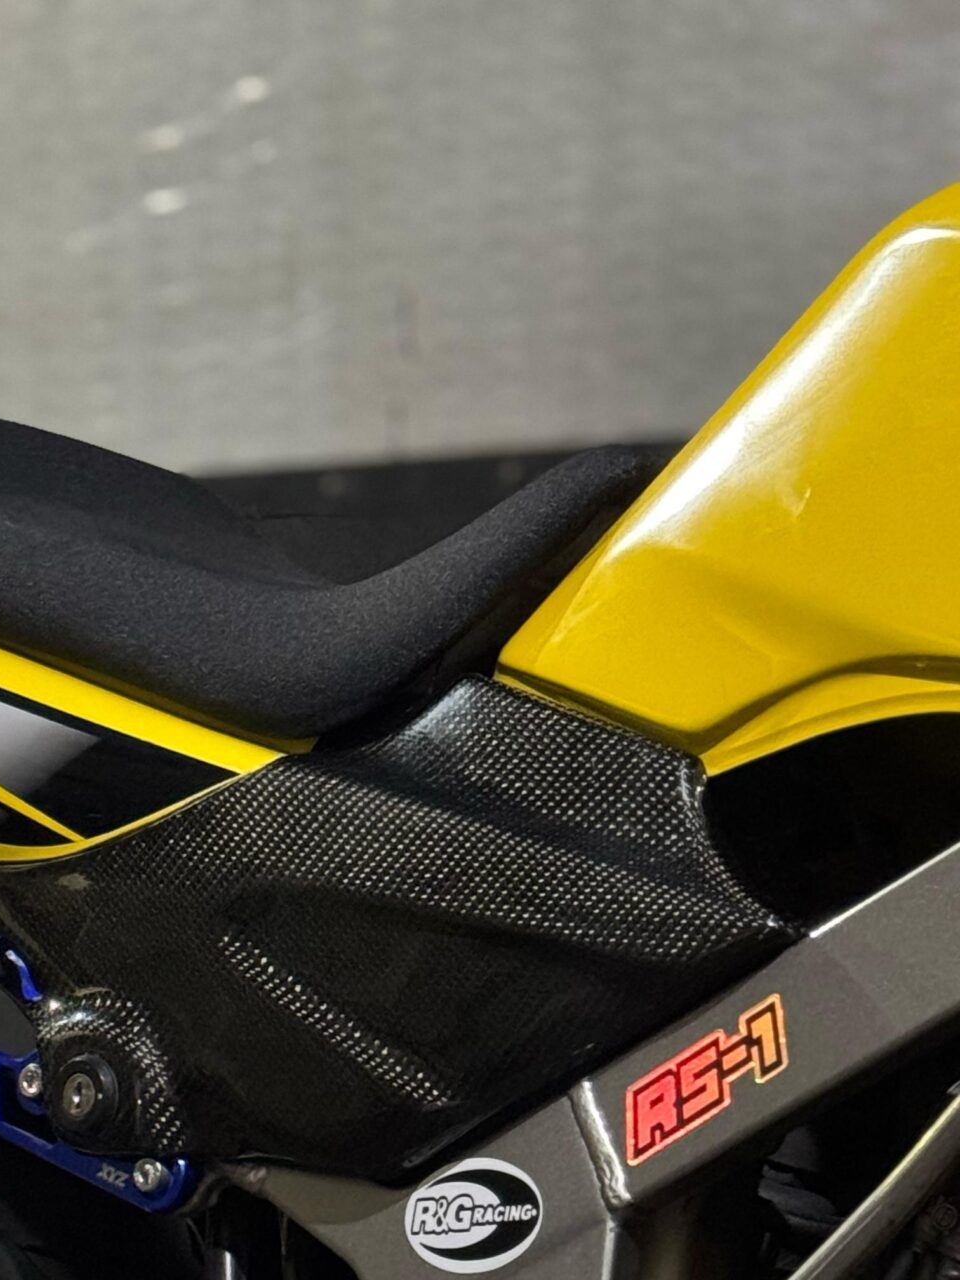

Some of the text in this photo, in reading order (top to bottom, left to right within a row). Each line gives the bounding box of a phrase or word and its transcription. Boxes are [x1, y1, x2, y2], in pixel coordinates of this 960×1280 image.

[629, 997, 787, 1162] RS-1
[411, 1193, 532, 1235] R&G RACING
